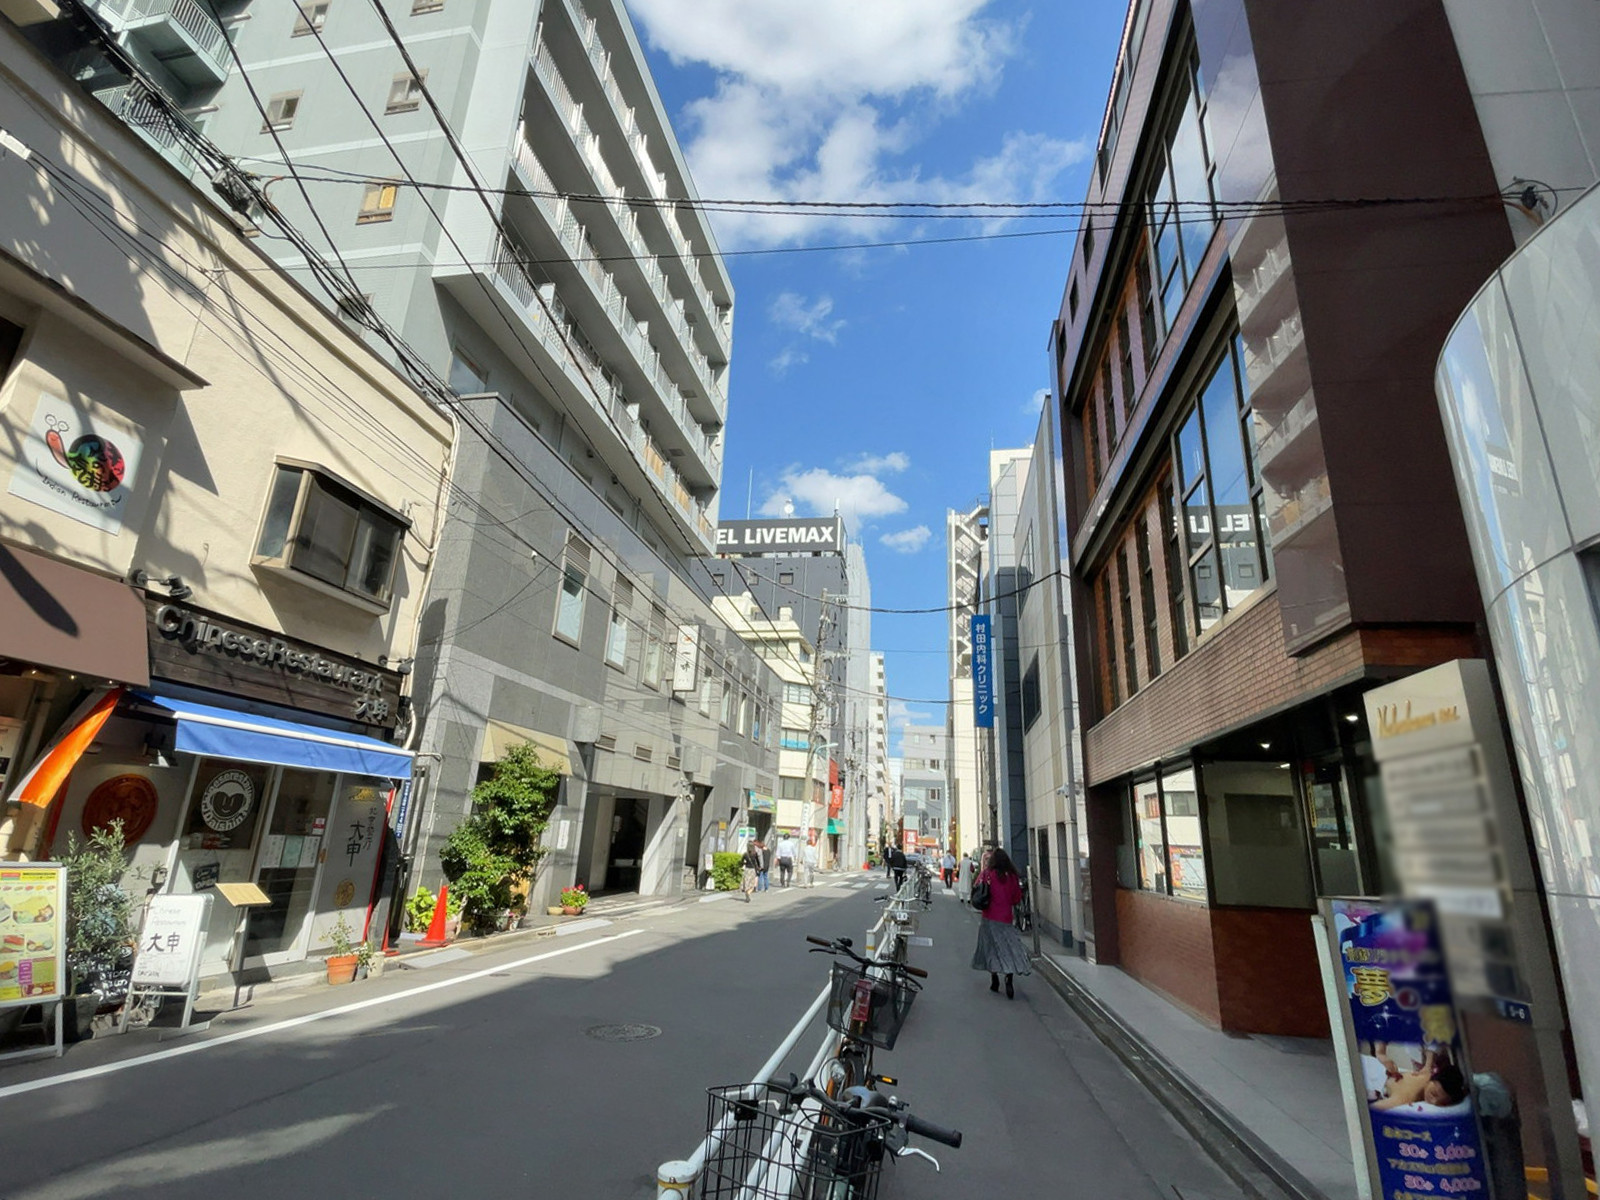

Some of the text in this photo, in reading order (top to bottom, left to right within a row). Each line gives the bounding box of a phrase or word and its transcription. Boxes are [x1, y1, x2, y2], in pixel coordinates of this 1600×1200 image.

[975, 623, 988, 714] 村田内科クリニック
[346, 820, 366, 868] 大申
[146, 931, 181, 953] 大申
